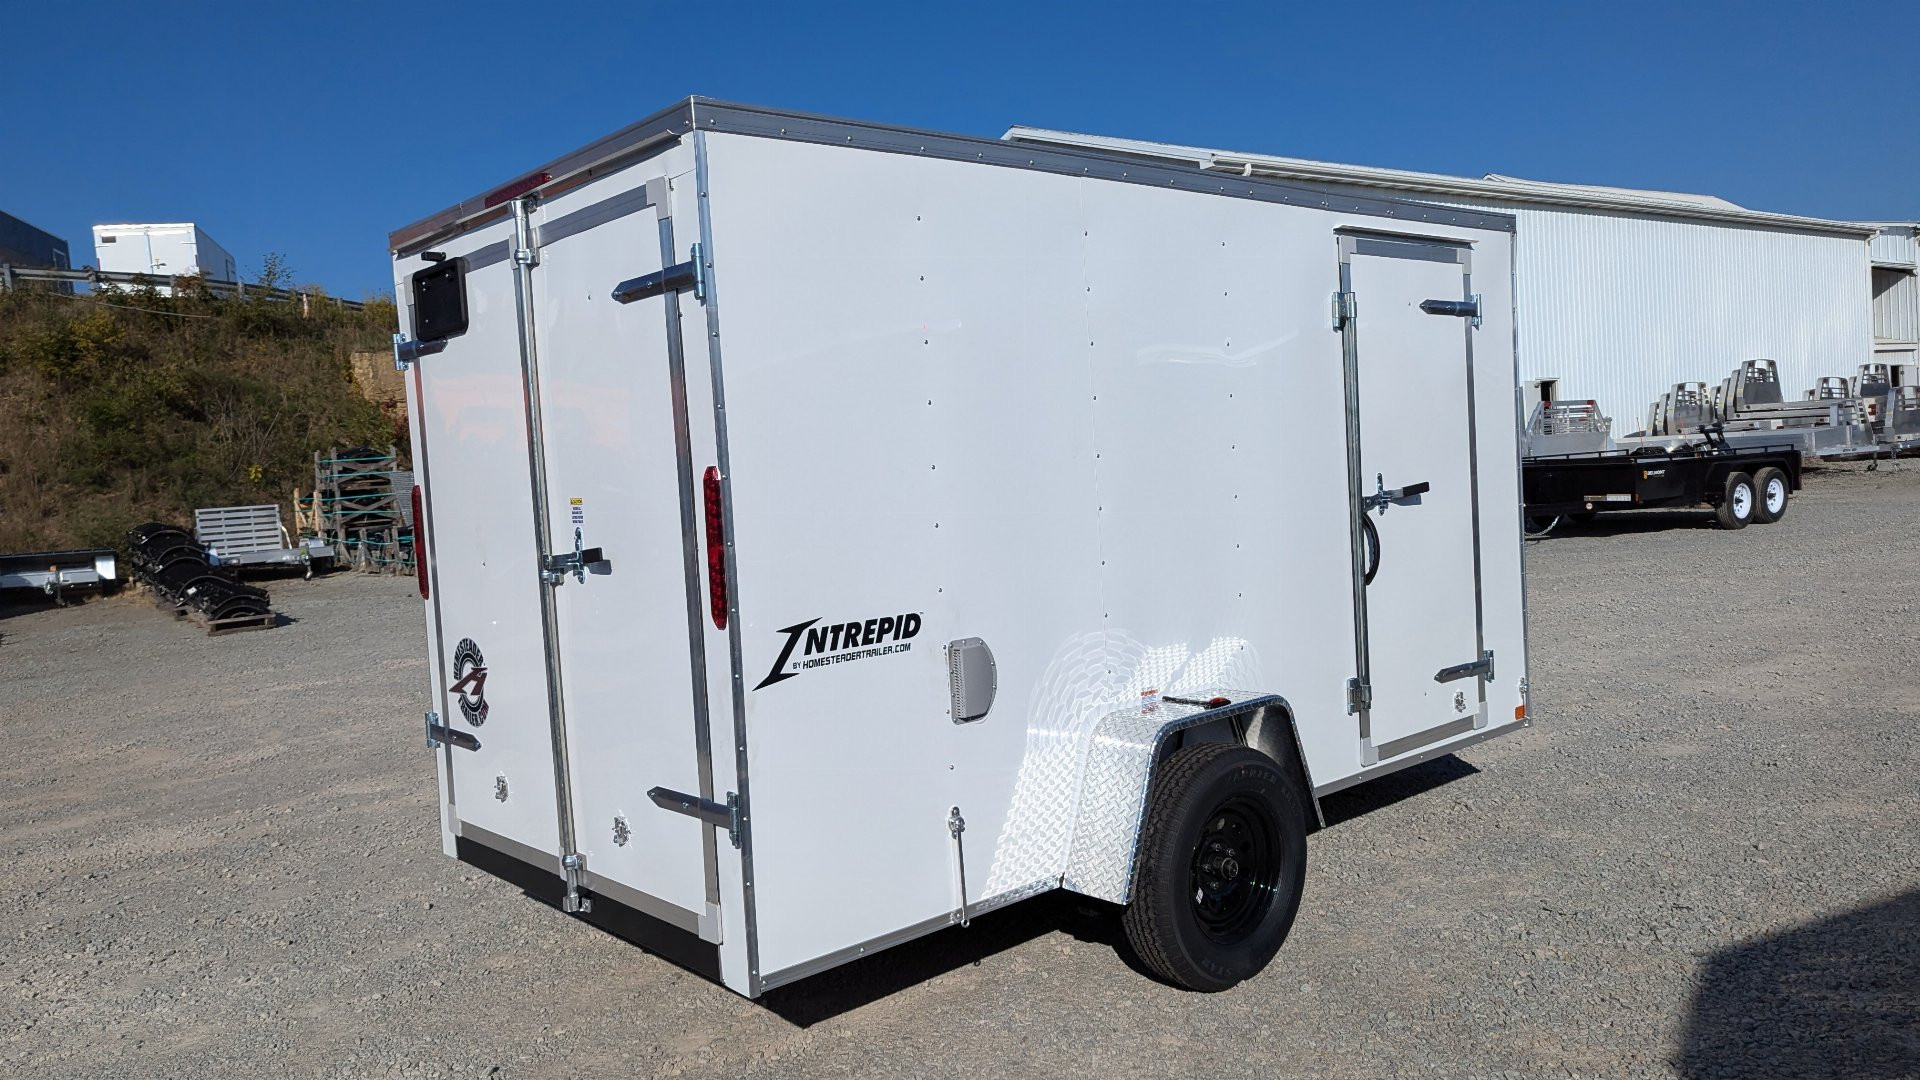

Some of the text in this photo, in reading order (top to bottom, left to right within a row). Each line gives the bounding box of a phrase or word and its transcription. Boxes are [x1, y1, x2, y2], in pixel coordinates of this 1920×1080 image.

[454, 638, 483, 680] HOMESTEADER
[752, 612, 922, 691] INTREPID
[802, 643, 911, 669] HOMESTEADERTRAILER.COM
